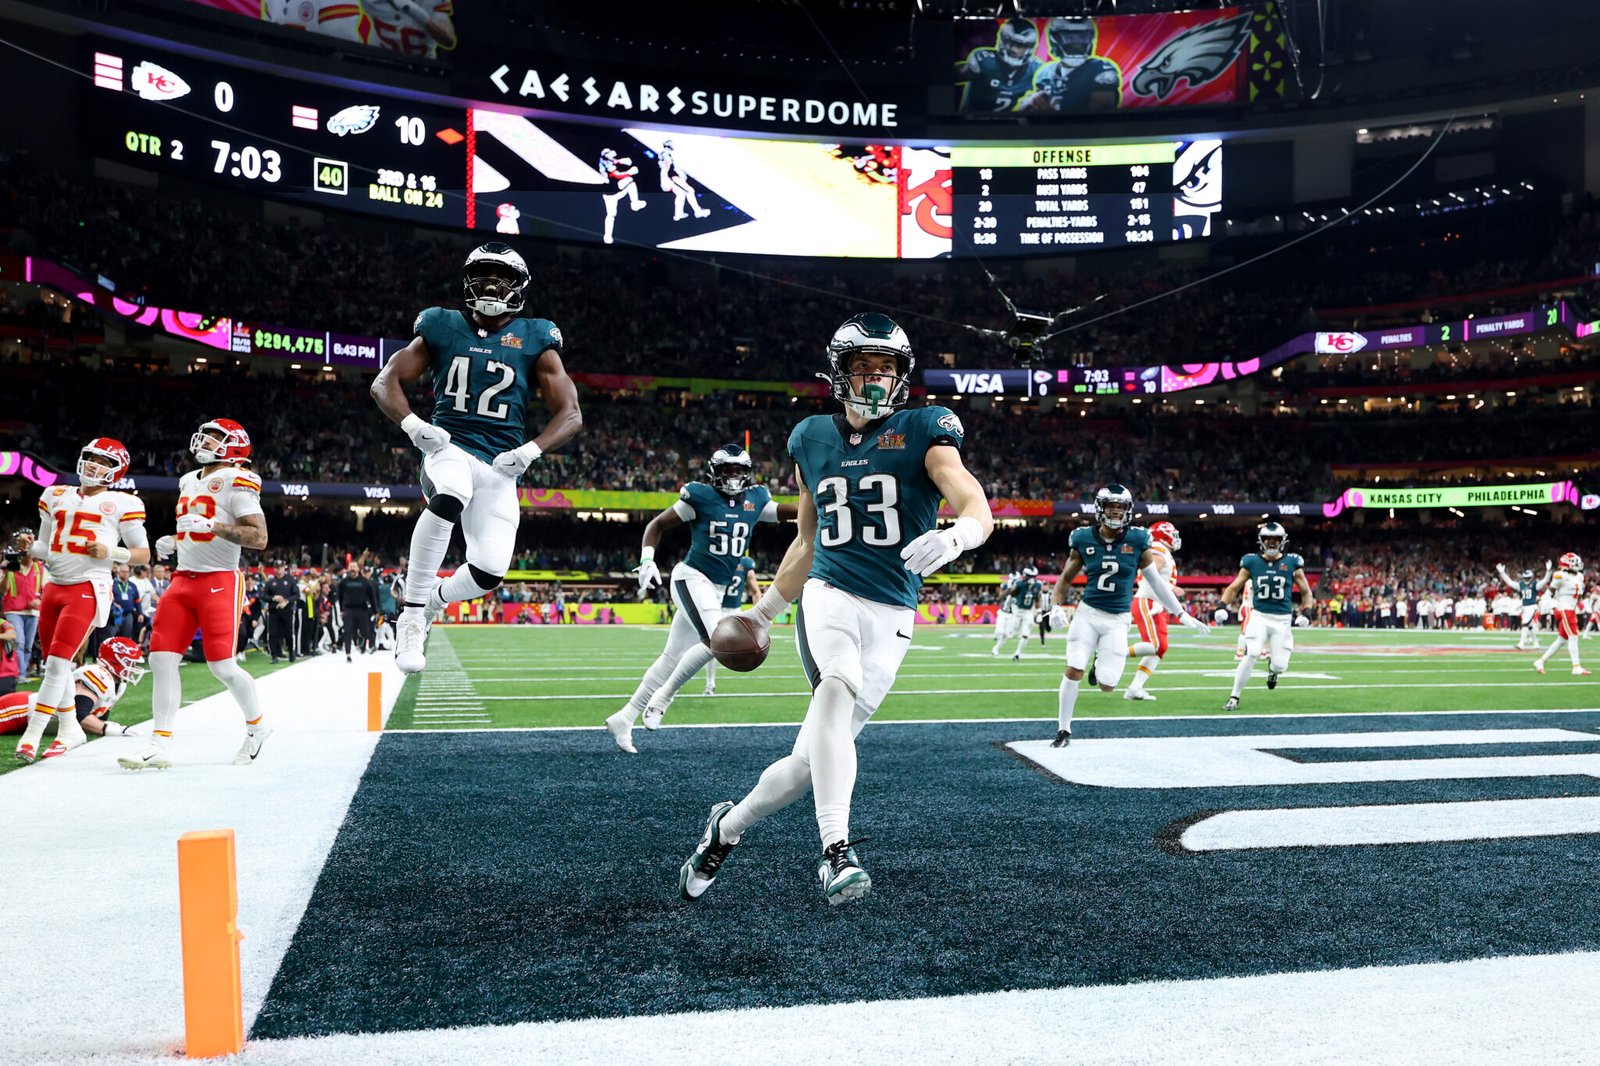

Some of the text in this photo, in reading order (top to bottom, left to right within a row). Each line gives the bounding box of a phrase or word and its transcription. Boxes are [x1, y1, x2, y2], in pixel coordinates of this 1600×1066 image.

[214, 81, 234, 112] 0
[490, 64, 898, 127] CAESARS SUPERDOME
[395, 116, 425, 146] 10
[126, 131, 183, 160] QTR 2
[211, 140, 281, 182] 7:03
[1033, 150, 1092, 163] OFFENSE
[319, 166, 342, 187] 40
[377, 168, 404, 187] 3RD
[406, 173, 417, 189] &
[1037, 168, 1059, 180] PASS
[1060, 167, 1088, 179] YARDS
[369, 184, 444, 208] BALL ON 24
[981, 184, 990, 197] 2
[1060, 183, 1088, 195] YARDS
[1132, 181, 1146, 193] 47
[1035, 200, 1060, 212] TOTAL
[1061, 199, 1089, 211] YARDS
[1026, 215, 1098, 228] PENALTIES-YARDS
[1020, 232, 1040, 244] TIME
[1041, 232, 1053, 244] OF
[1054, 231, 1104, 244] POSSESSION
[1547, 308, 1558, 326] 20
[1441, 325, 1450, 341] 2
[1476, 319, 1525, 334] PENALTY YARDS
[255, 329, 324, 355] $294,475
[358, 346, 376, 359] PM
[1381, 333, 1412, 344] PENALTIES
[469, 346, 493, 354] EAGLES
[950, 374, 1004, 393] VISA
[1083, 370, 1109, 382] 7:03
[444, 356, 515, 419] 42
[1039, 383, 1048, 396] 0
[1143, 380, 1157, 393] 10
[841, 459, 869, 467] EAGLES
[281, 484, 309, 495] VISA
[363, 487, 391, 498] VISA
[1370, 489, 1545, 504] KANSAS CITY PHILADELPHIA
[817, 474, 901, 547] 33
[1146, 504, 1169, 514] VISA
[1212, 505, 1235, 514] VISA
[1277, 505, 1300, 514] VISA
[51, 510, 102, 556] 15
[709, 520, 749, 557] 58
[1097, 561, 1119, 592] 2
[1257, 575, 1286, 599] 53
